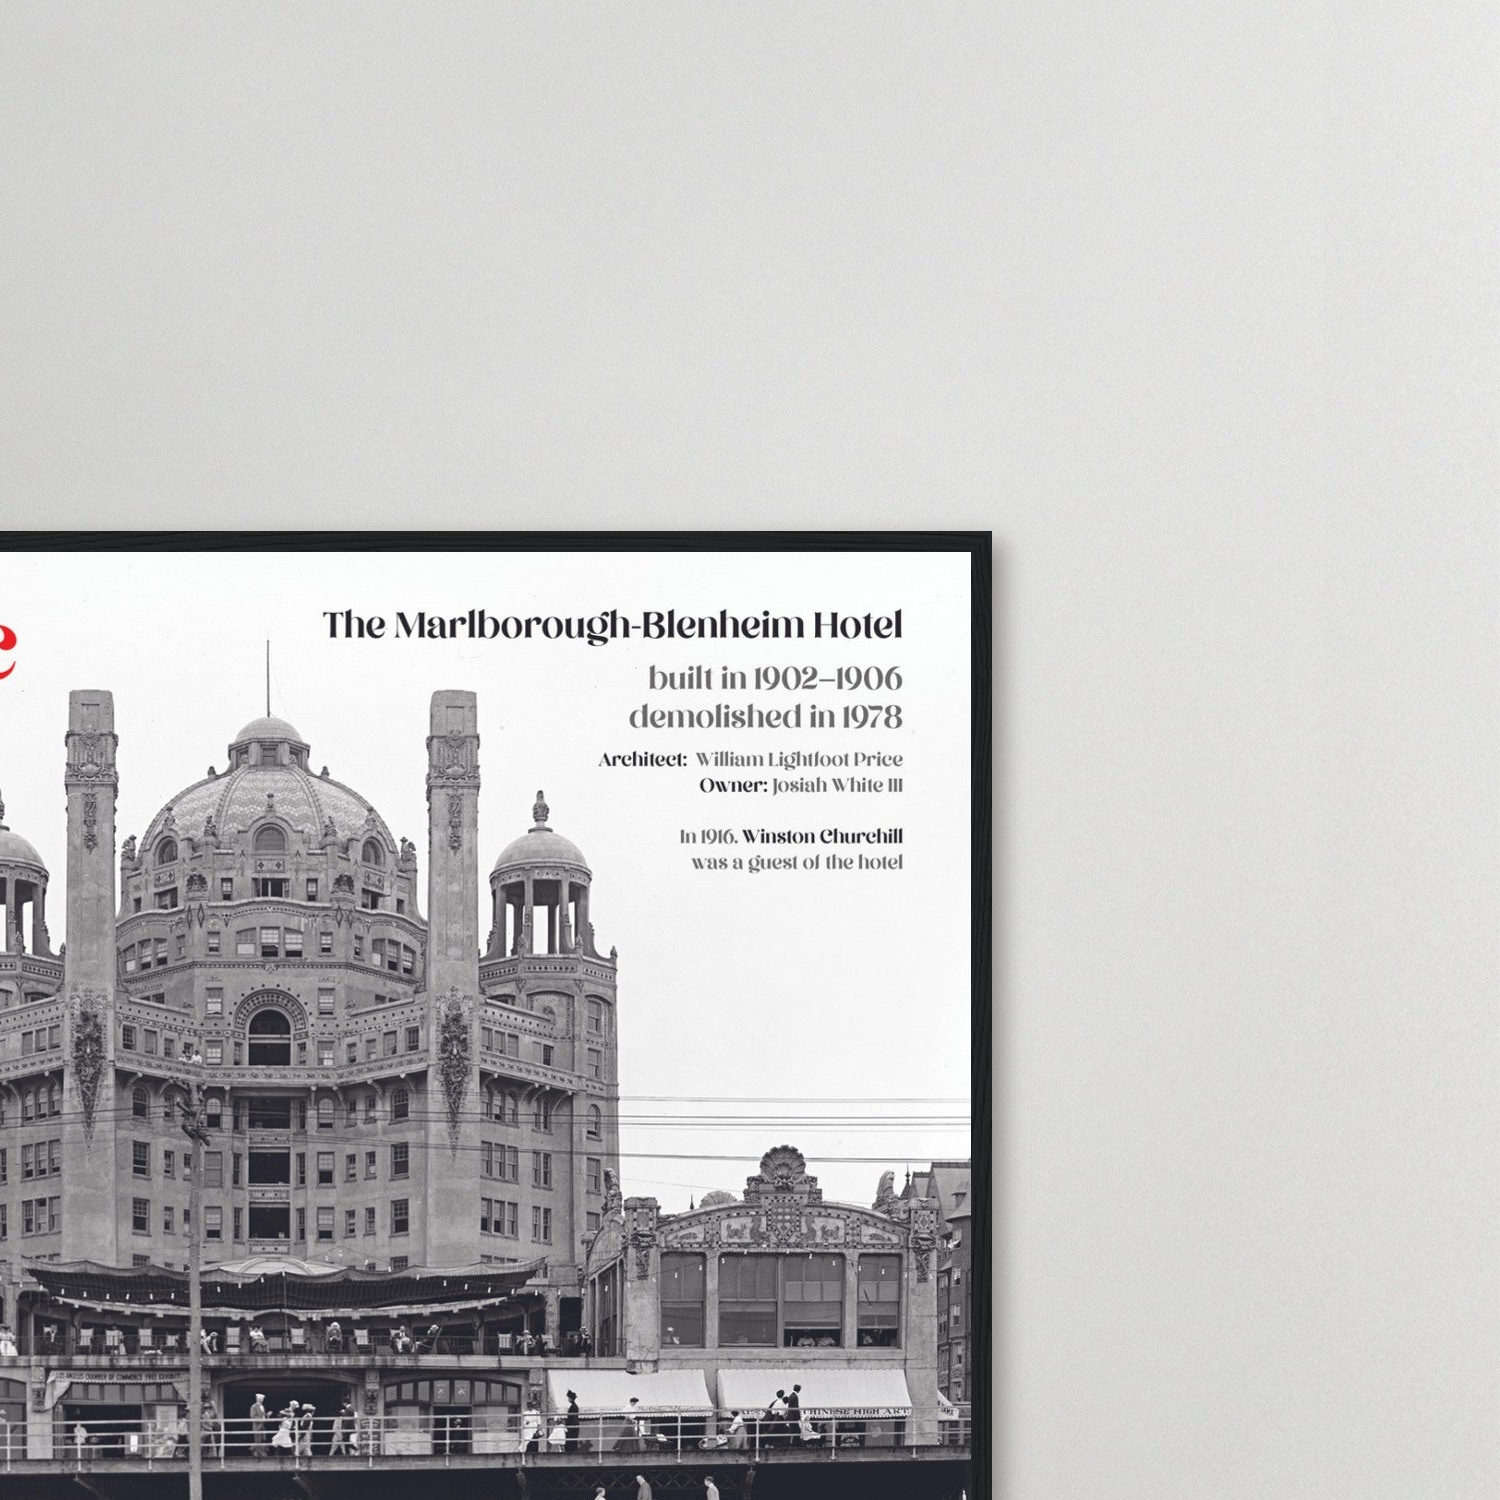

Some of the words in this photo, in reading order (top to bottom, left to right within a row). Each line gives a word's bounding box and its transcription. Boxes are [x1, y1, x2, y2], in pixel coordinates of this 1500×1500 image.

[323, 609, 385, 639] The
[395, 609, 804, 646] Marlborough-Blenheim
[815, 609, 902, 639] Hotel
[650, 665, 712, 690] built
[722, 666, 746, 690] in
[630, 704, 801, 729] demolished
[811, 705, 834, 728] in
[844, 705, 902, 729] 1978
[599, 751, 687, 767] Architect:
[696, 751, 763, 767] William
[769, 751, 848, 771] Lightfoot
[855, 752, 903, 767] Price
[700, 778, 767, 793] Owner:
[773, 777, 826, 796] Josiah
[832, 777, 883, 793] White
[889, 779, 902, 793] III
[681, 829, 696, 844] In
[742, 829, 815, 844] Winston
[820, 828, 902, 844] Churchill
[692, 858, 728, 870] was
[733, 858, 743, 870] a
[749, 855, 797, 874] guest
[803, 855, 820, 870] of
[826, 854, 853, 870] the
[859, 854, 902, 870] hotel
[803, 1407, 850, 1415] CHINESE
[853, 1407, 880, 1415] HIGH
